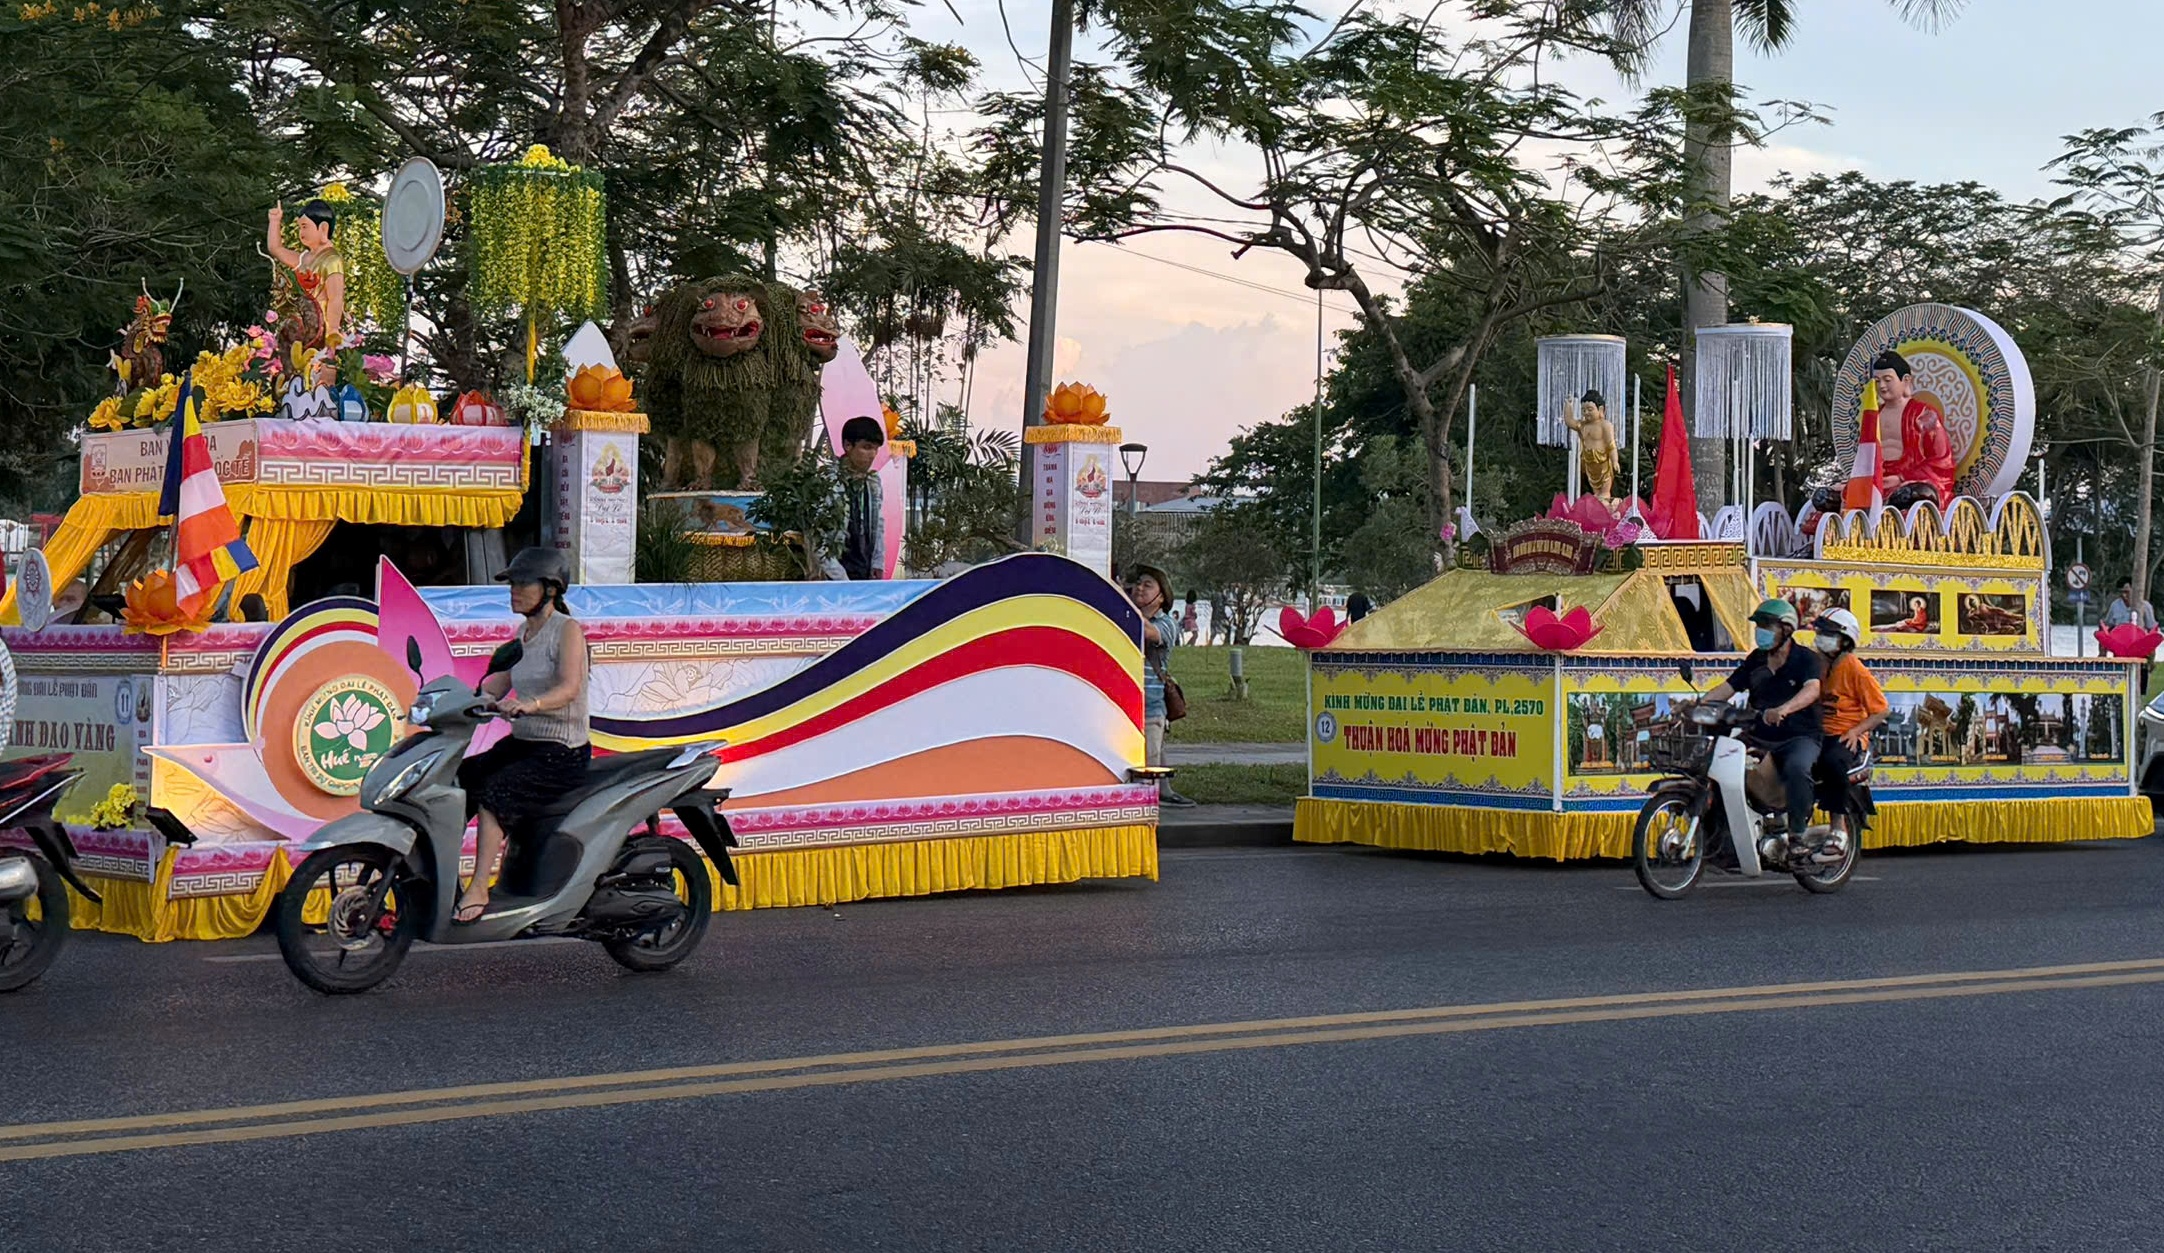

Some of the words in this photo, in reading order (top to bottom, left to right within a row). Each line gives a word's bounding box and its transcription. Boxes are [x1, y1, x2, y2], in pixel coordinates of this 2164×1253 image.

[140, 440, 163, 457] BAN
[109, 467, 132, 484] BAN
[214, 454, 230, 476] ỐC
[121, 693, 130, 713] 11
[1324, 692, 1350, 710] KÍNH
[1354, 692, 1384, 711] MỪNG
[1388, 697, 1407, 714] ĐẠI
[1429, 694, 1458, 716] PHẬT
[74, 717, 115, 751] VÀNG
[1321, 720, 1330, 734] 12
[1343, 720, 1384, 757] THUẬN
[1387, 720, 1411, 753] HOÁ
[1415, 721, 1449, 755] MỪNG
[1452, 724, 1487, 762] PHẬT
[1491, 722, 1517, 758] ĐẢN
[320, 746, 351, 770] Huế
